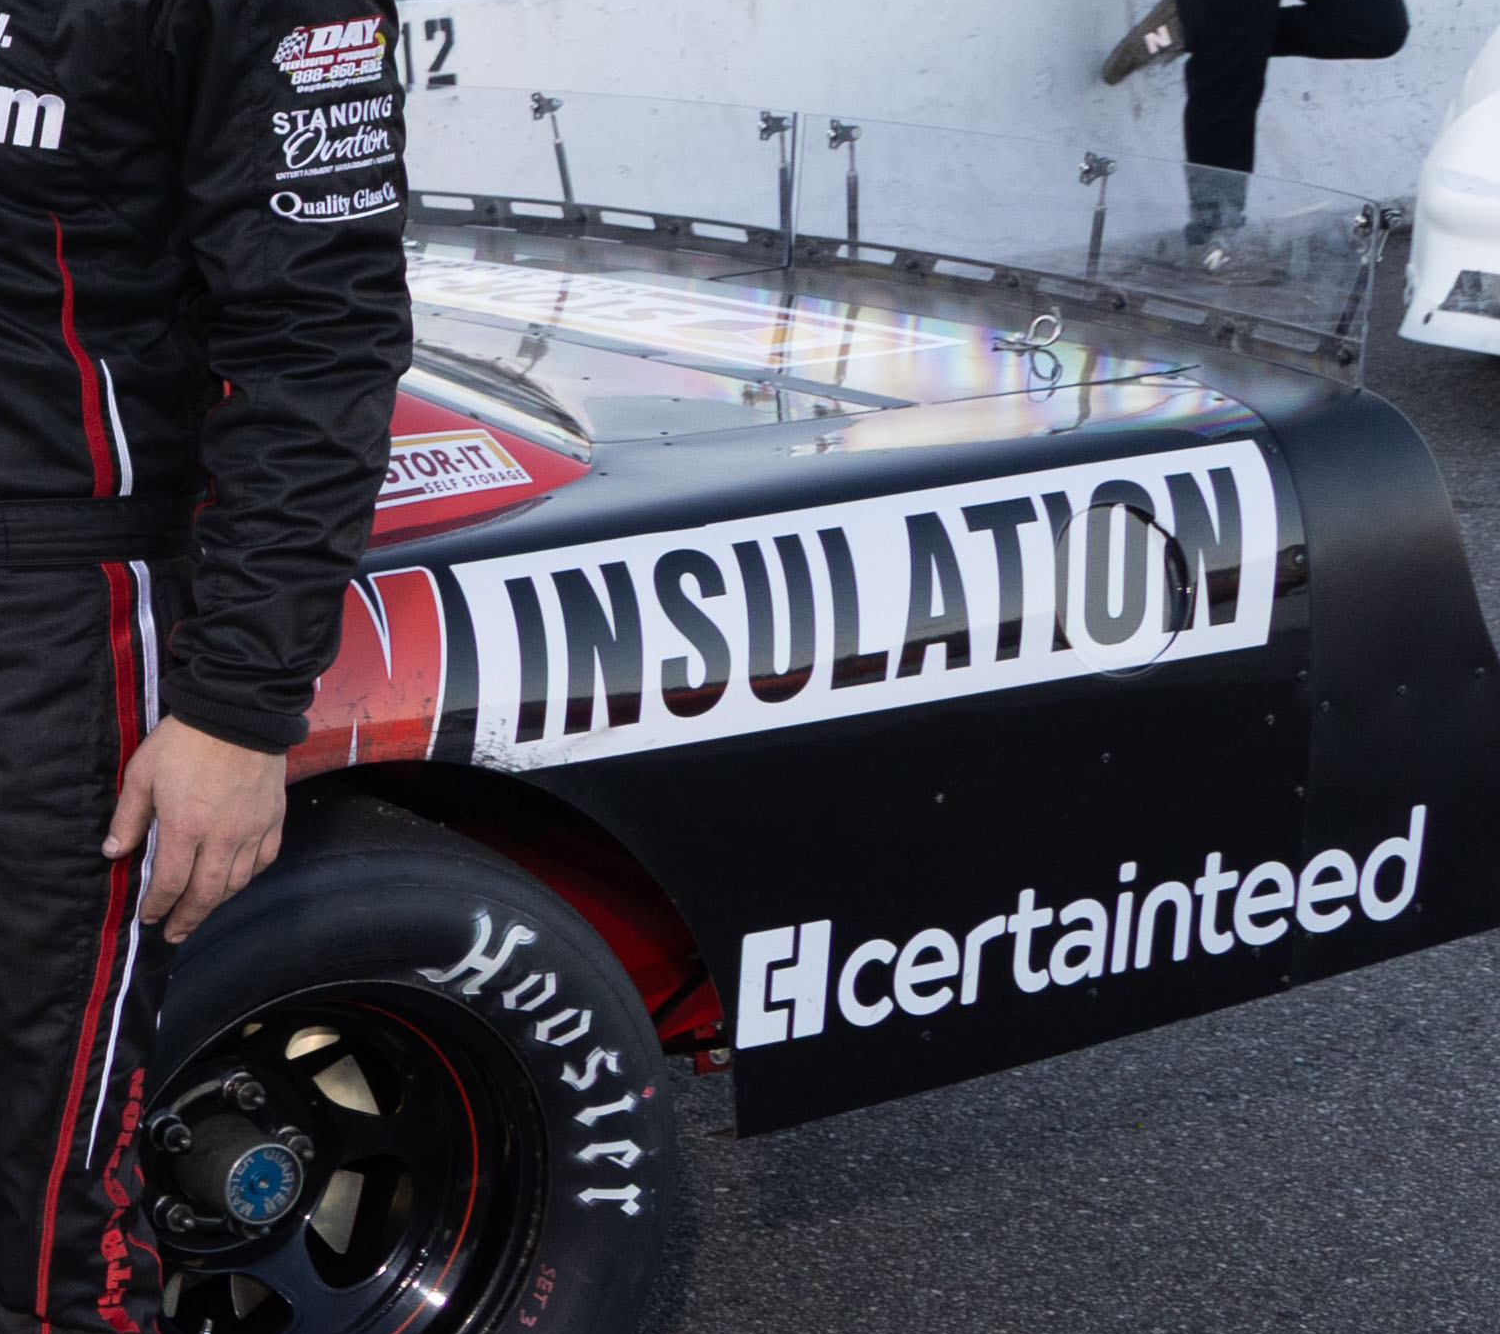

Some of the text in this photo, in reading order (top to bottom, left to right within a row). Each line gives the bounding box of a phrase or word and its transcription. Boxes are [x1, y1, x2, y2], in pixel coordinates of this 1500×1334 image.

[307, 17, 381, 53] DAY
[401, 17, 457, 90] 12
[272, 94, 393, 135] STANDING
[283, 124, 390, 169] Ovation
[270, 190, 351, 222] Quality
[353, 187, 383, 210] Glass
[424, 469, 526, 494] SELF STORAGE
[503, 466, 1241, 744] INSULATION
[837, 804, 1427, 1029] certainteed
[417, 910, 643, 1217] Hoosier
[520, 1263, 557, 1326] SET 3
